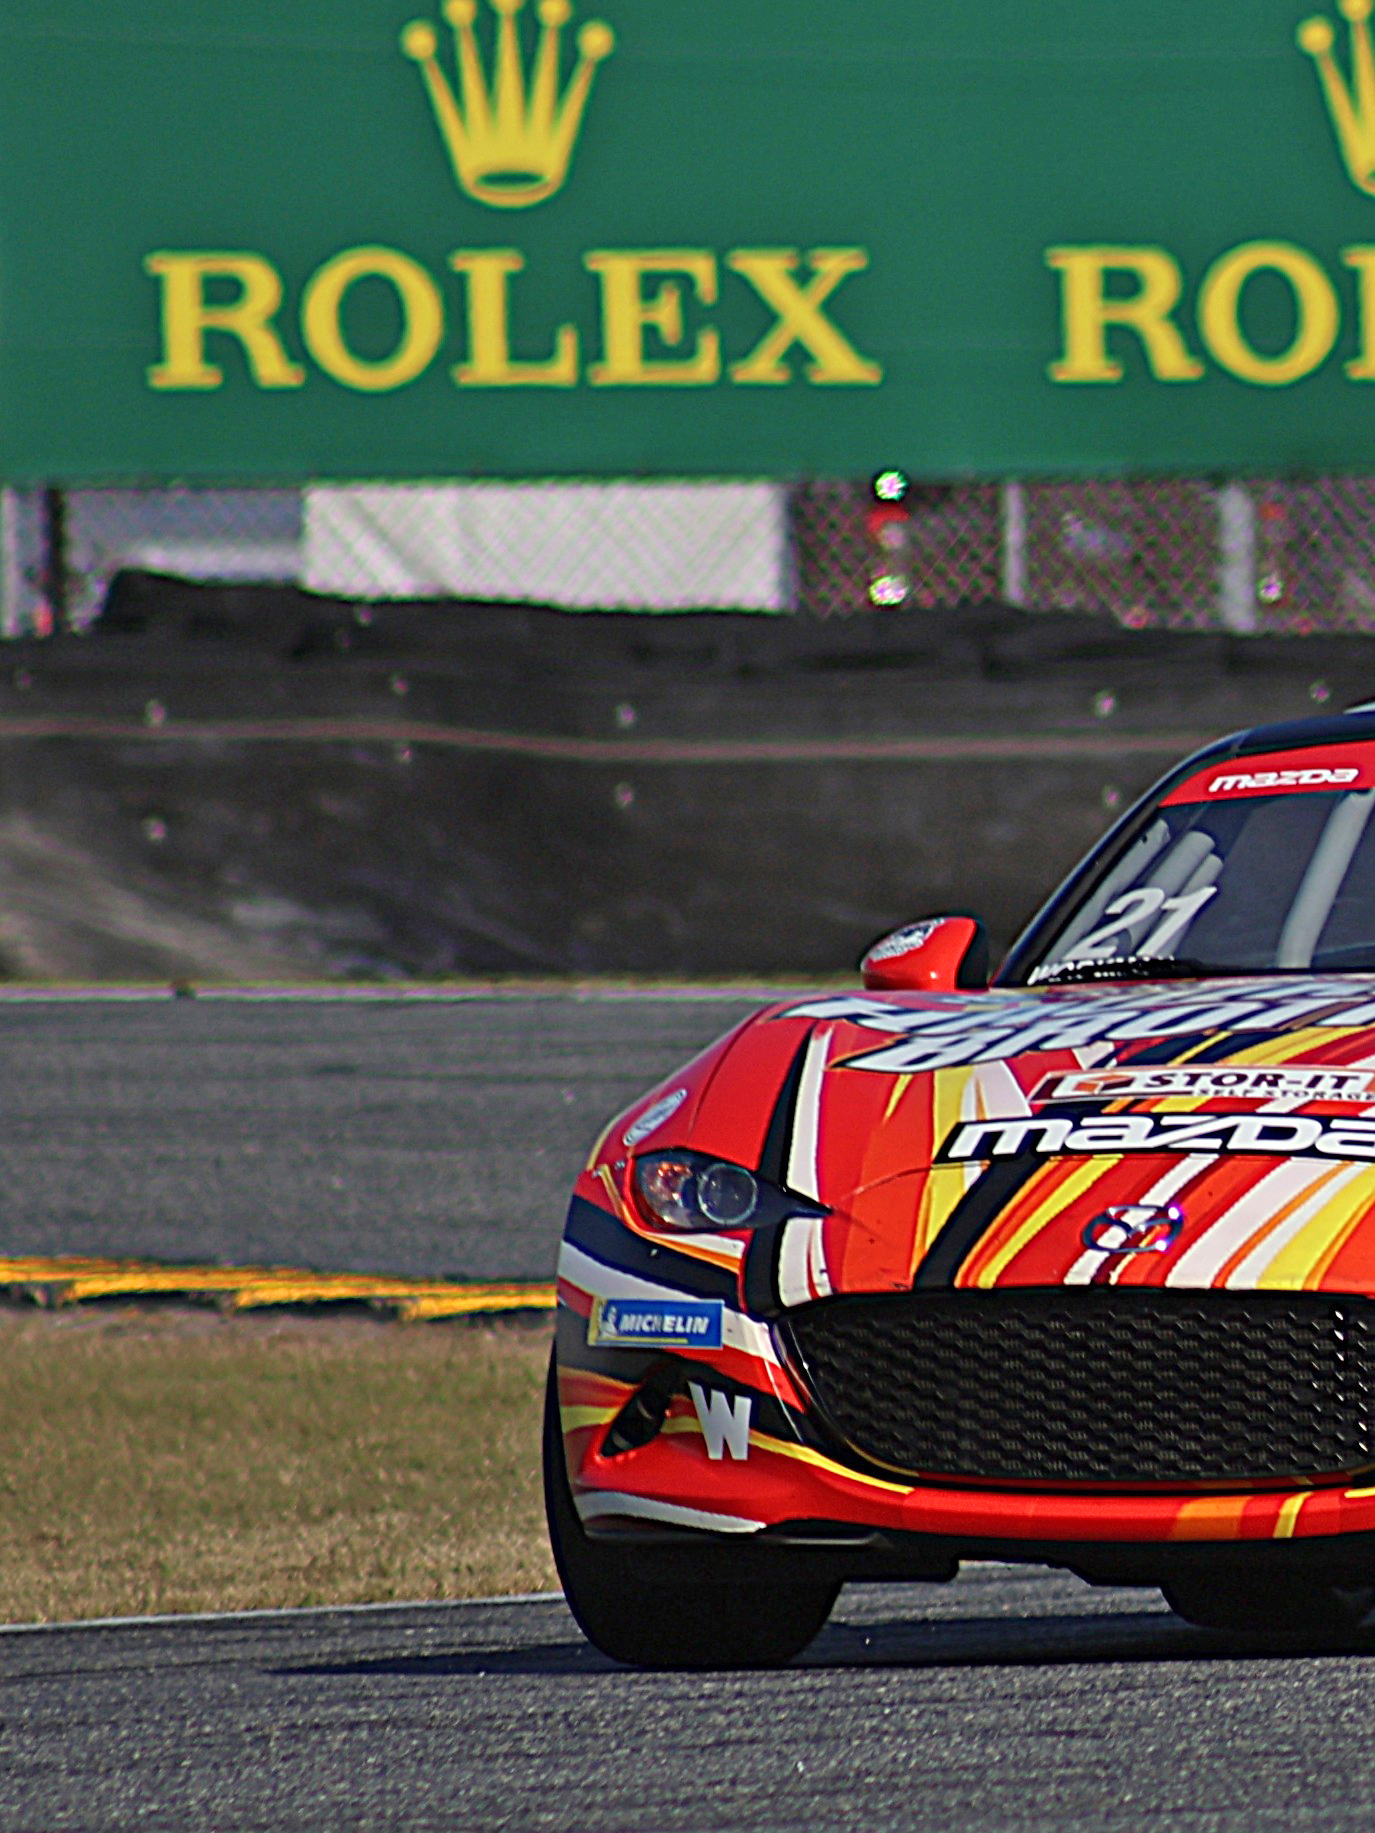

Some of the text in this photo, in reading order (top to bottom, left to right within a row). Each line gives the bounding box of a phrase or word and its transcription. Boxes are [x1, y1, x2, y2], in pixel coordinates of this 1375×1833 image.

[146, 246, 882, 391] ROLEX
[1062, 886, 1218, 960] 21
[1146, 1073, 1362, 1090] STOR-IT
[619, 1313, 710, 1335] MICHELIN
[689, 1381, 752, 1461] W
